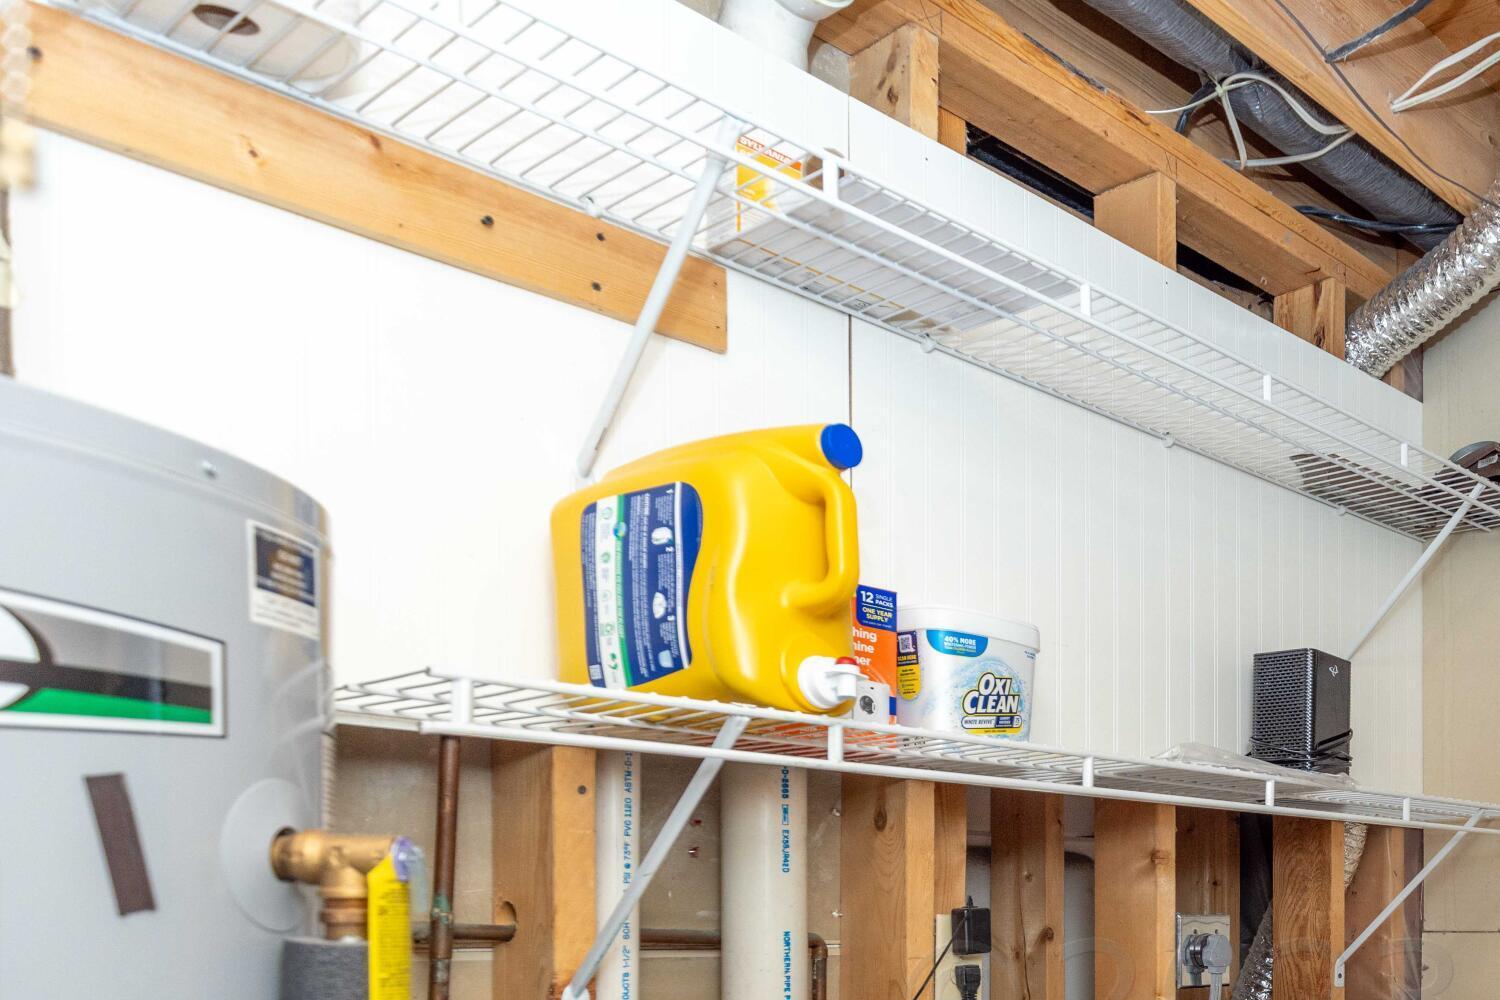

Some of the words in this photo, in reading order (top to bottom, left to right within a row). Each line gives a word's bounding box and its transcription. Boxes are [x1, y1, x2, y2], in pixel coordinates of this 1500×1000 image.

[860, 590, 874, 604] 12
[875, 593, 893, 602] SINGLE
[875, 600, 894, 608] PACKS
[861, 606, 876, 614] ONE
[876, 609, 893, 618] YEAR
[866, 614, 889, 622] SUPPLY
[959, 637, 977, 646] MORE
[979, 672, 1011, 695] OXI
[963, 690, 1019, 714] CLEAN
[623, 797, 633, 817] 1120
[623, 819, 632, 837] PVC
[783, 931, 791, 974] NORTHERN
[783, 975, 791, 992] PIPE
